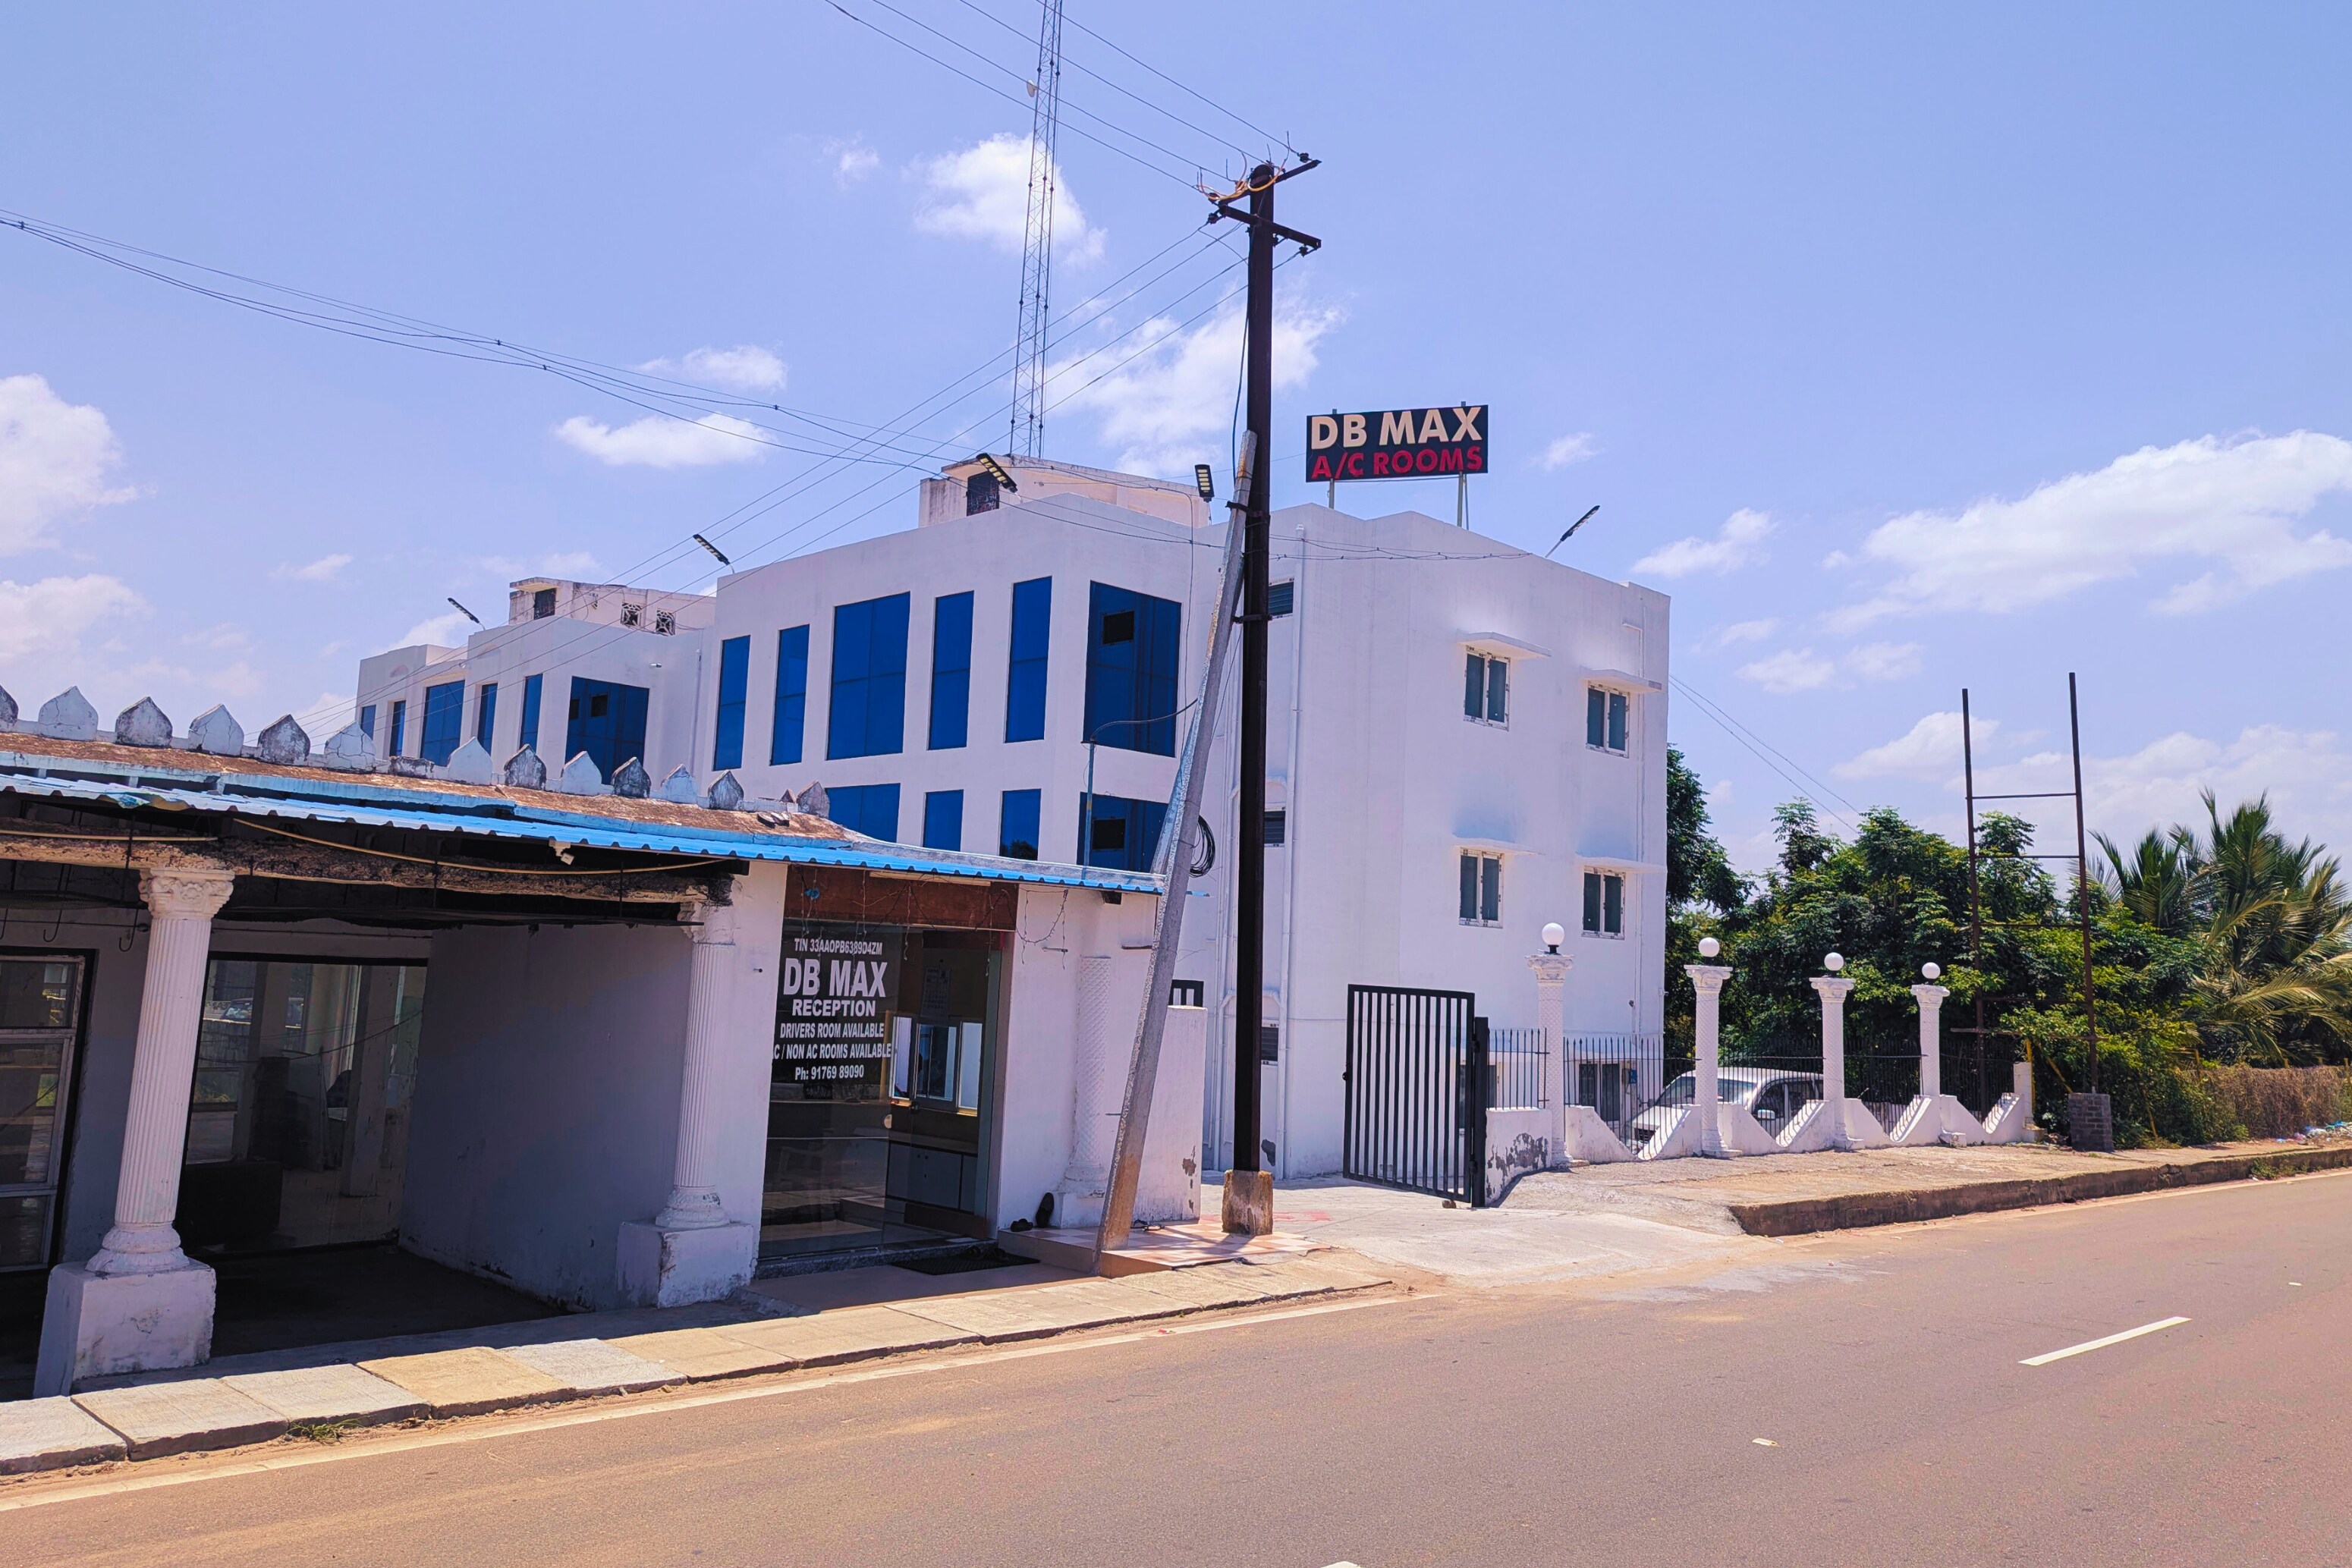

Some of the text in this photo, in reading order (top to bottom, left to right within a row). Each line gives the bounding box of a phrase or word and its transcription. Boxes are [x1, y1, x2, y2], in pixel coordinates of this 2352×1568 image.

[1311, 407, 1483, 450] DB MAX
[1311, 445, 1483, 479] A/C ROOMS
[794, 938, 808, 951] TIN
[783, 957, 820, 996] DB
[829, 960, 888, 998] MAX
[792, 999, 876, 1017] RECEPTION
[780, 1023, 885, 1039] DRIVERS ROOM AVAILABLE
[786, 1044, 805, 1060] NON
[806, 1043, 818, 1059] AC
[819, 1043, 848, 1059] ROOMS
[850, 1043, 891, 1058] AVAILABLE
[795, 1064, 864, 1081] Ph: 91769 89090
